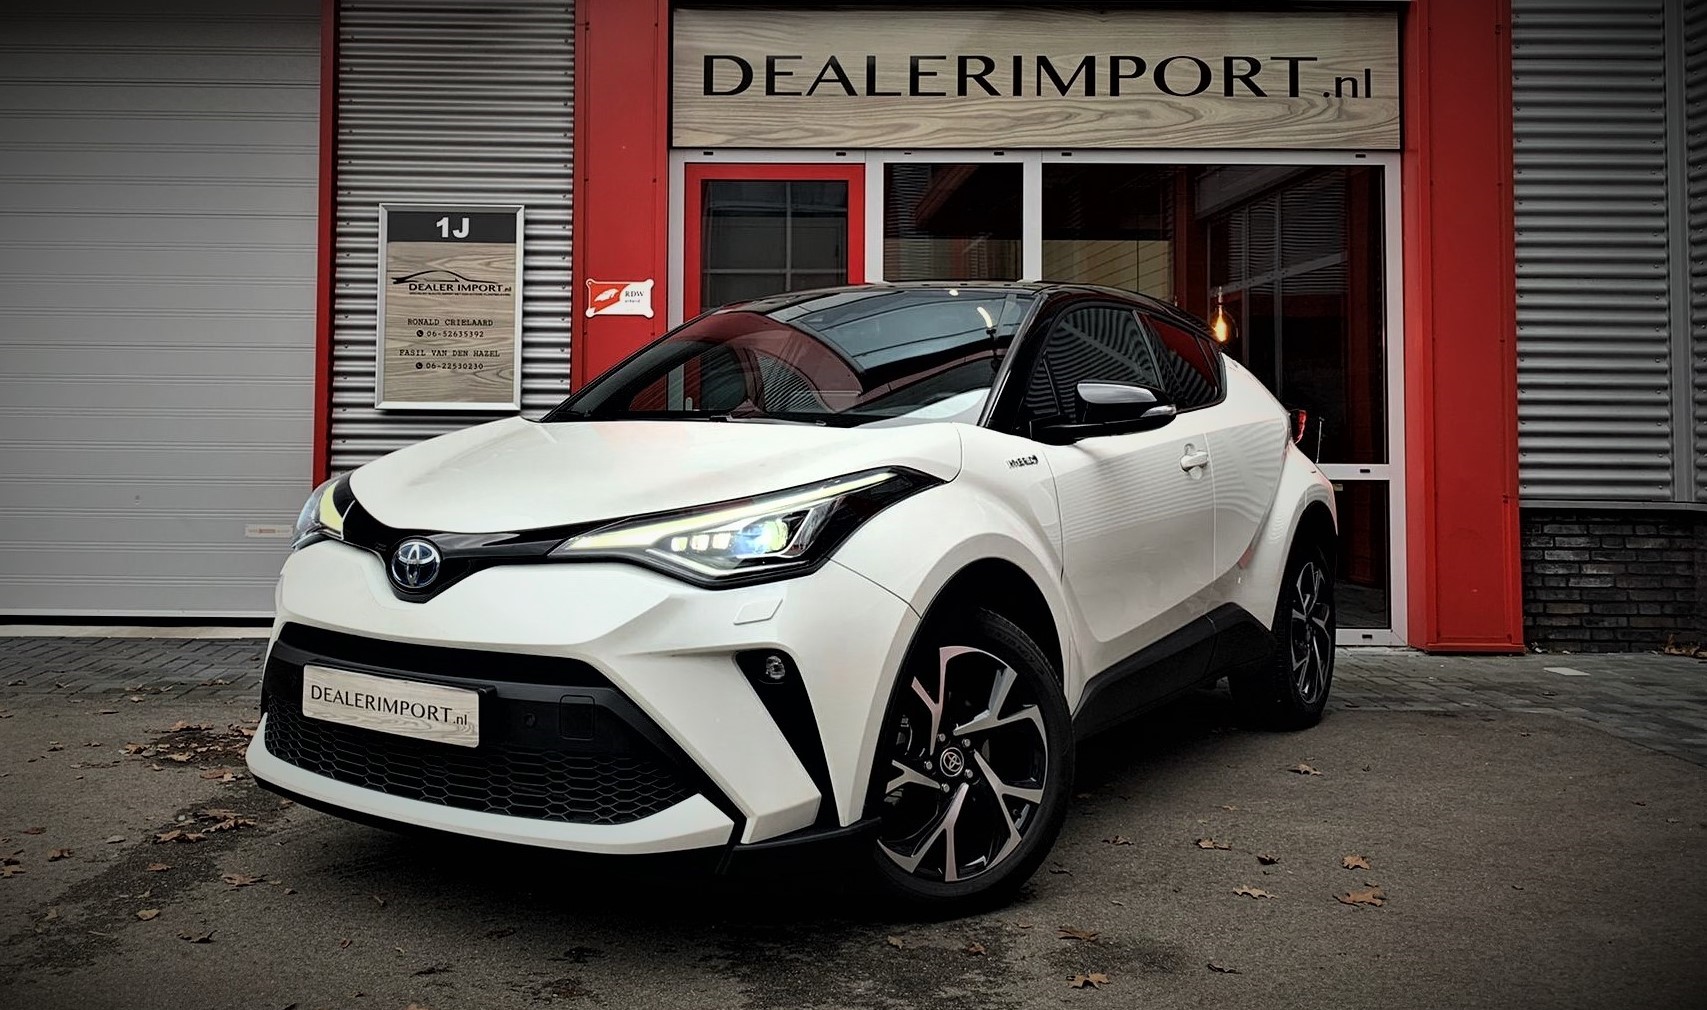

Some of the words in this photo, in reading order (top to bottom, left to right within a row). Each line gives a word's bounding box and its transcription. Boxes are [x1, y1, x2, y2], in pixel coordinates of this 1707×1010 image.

[703, 55, 1372, 98] DEALERIMPORT.nl
[436, 217, 470, 239] 1J
[408, 283, 454, 292] DEALER
[407, 318, 440, 326] RONALD
[444, 318, 494, 327] CRIELAARD
[426, 330, 484, 338] 06-52635392
[431, 349, 447, 357] VAN
[452, 349, 469, 357] DEN
[473, 350, 500, 358] HAZEL
[310, 684, 468, 726] DEALERIMPORT.nl
